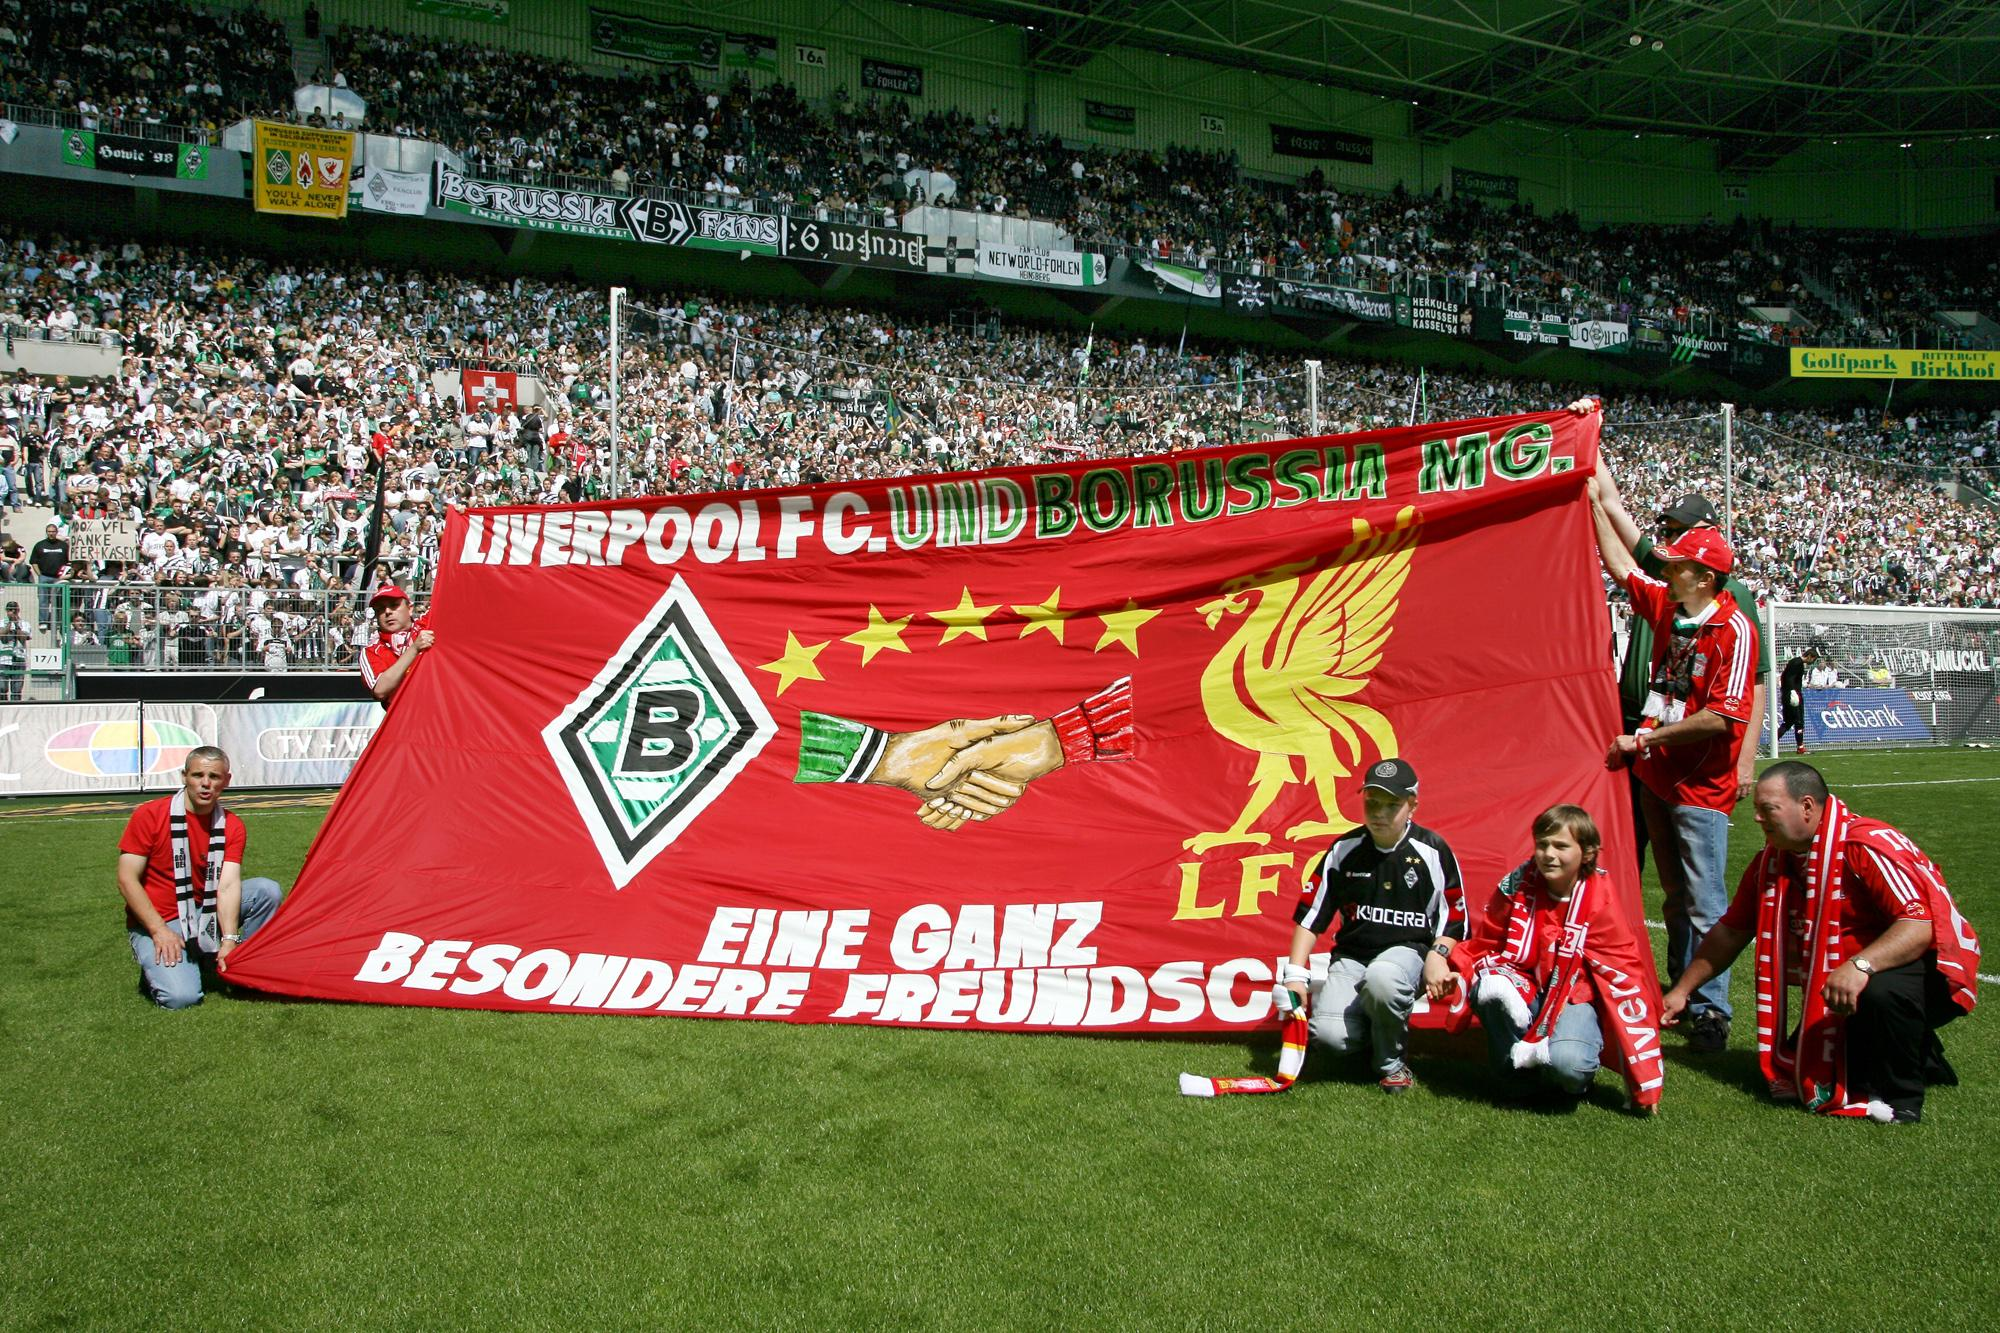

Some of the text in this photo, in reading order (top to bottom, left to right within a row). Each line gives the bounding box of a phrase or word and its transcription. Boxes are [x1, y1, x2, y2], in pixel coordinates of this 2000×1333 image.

[798, 48, 824, 64] 16A
[1203, 118, 1223, 132] 15A
[266, 190, 302, 200] YOU'LL
[307, 193, 341, 202] NEVER
[269, 198, 337, 209] WALK ALONE
[441, 170, 617, 228] BORUSSIA
[698, 210, 780, 244] FANS
[469, 207, 521, 226] IMMER
[529, 219, 555, 230] UND
[1019, 245, 1050, 257] FAN-CLUB
[988, 250, 1080, 275] NETWORLD-FOHLEN
[1019, 270, 1051, 282] HEINSBERG
[1412, 296, 1458, 313] HERKULES
[1412, 308, 1458, 325] BORUSSEN
[1412, 319, 1458, 336] KASSEL'94
[1672, 333, 1729, 352] NORDFRONT
[1801, 351, 1898, 374] Golfpark
[1922, 352, 1988, 361] RITTERGUT
[1911, 360, 1995, 378] Birkhof
[459, 422, 1576, 567] LIVERPOOL FC. UND BORUSSIA MG.
[102, 521, 129, 534] VFL
[70, 534, 112, 546] DANKE
[35, 655, 57, 664] 17/1
[1820, 701, 1904, 730] citibank
[277, 734, 312, 754] TV
[697, 900, 1104, 972] EINE GANZ
[353, 931, 811, 1016] BESONDERE
